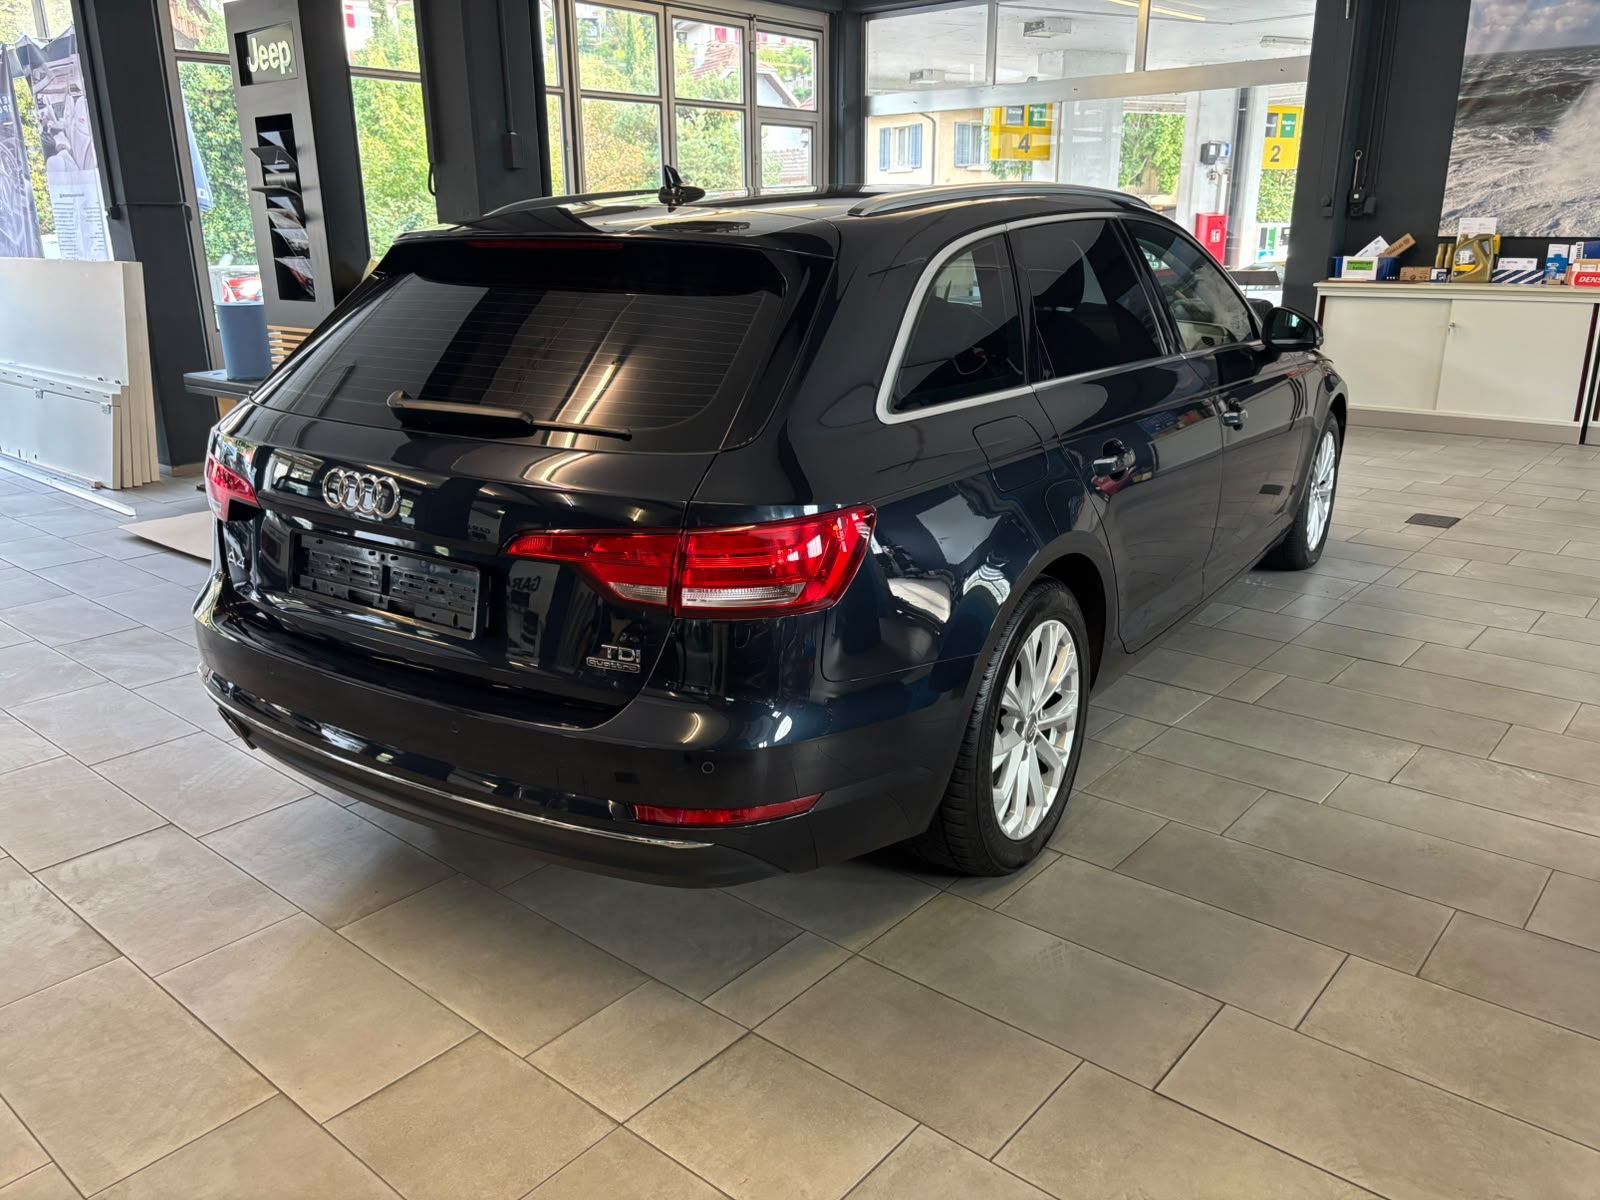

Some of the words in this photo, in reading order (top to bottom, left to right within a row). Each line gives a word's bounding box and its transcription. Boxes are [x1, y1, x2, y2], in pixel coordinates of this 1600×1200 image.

[247, 37, 291, 75] Jeep
[1018, 133, 1031, 153] 4
[1269, 145, 1281, 163] 2
[227, 546, 245, 569] A4
